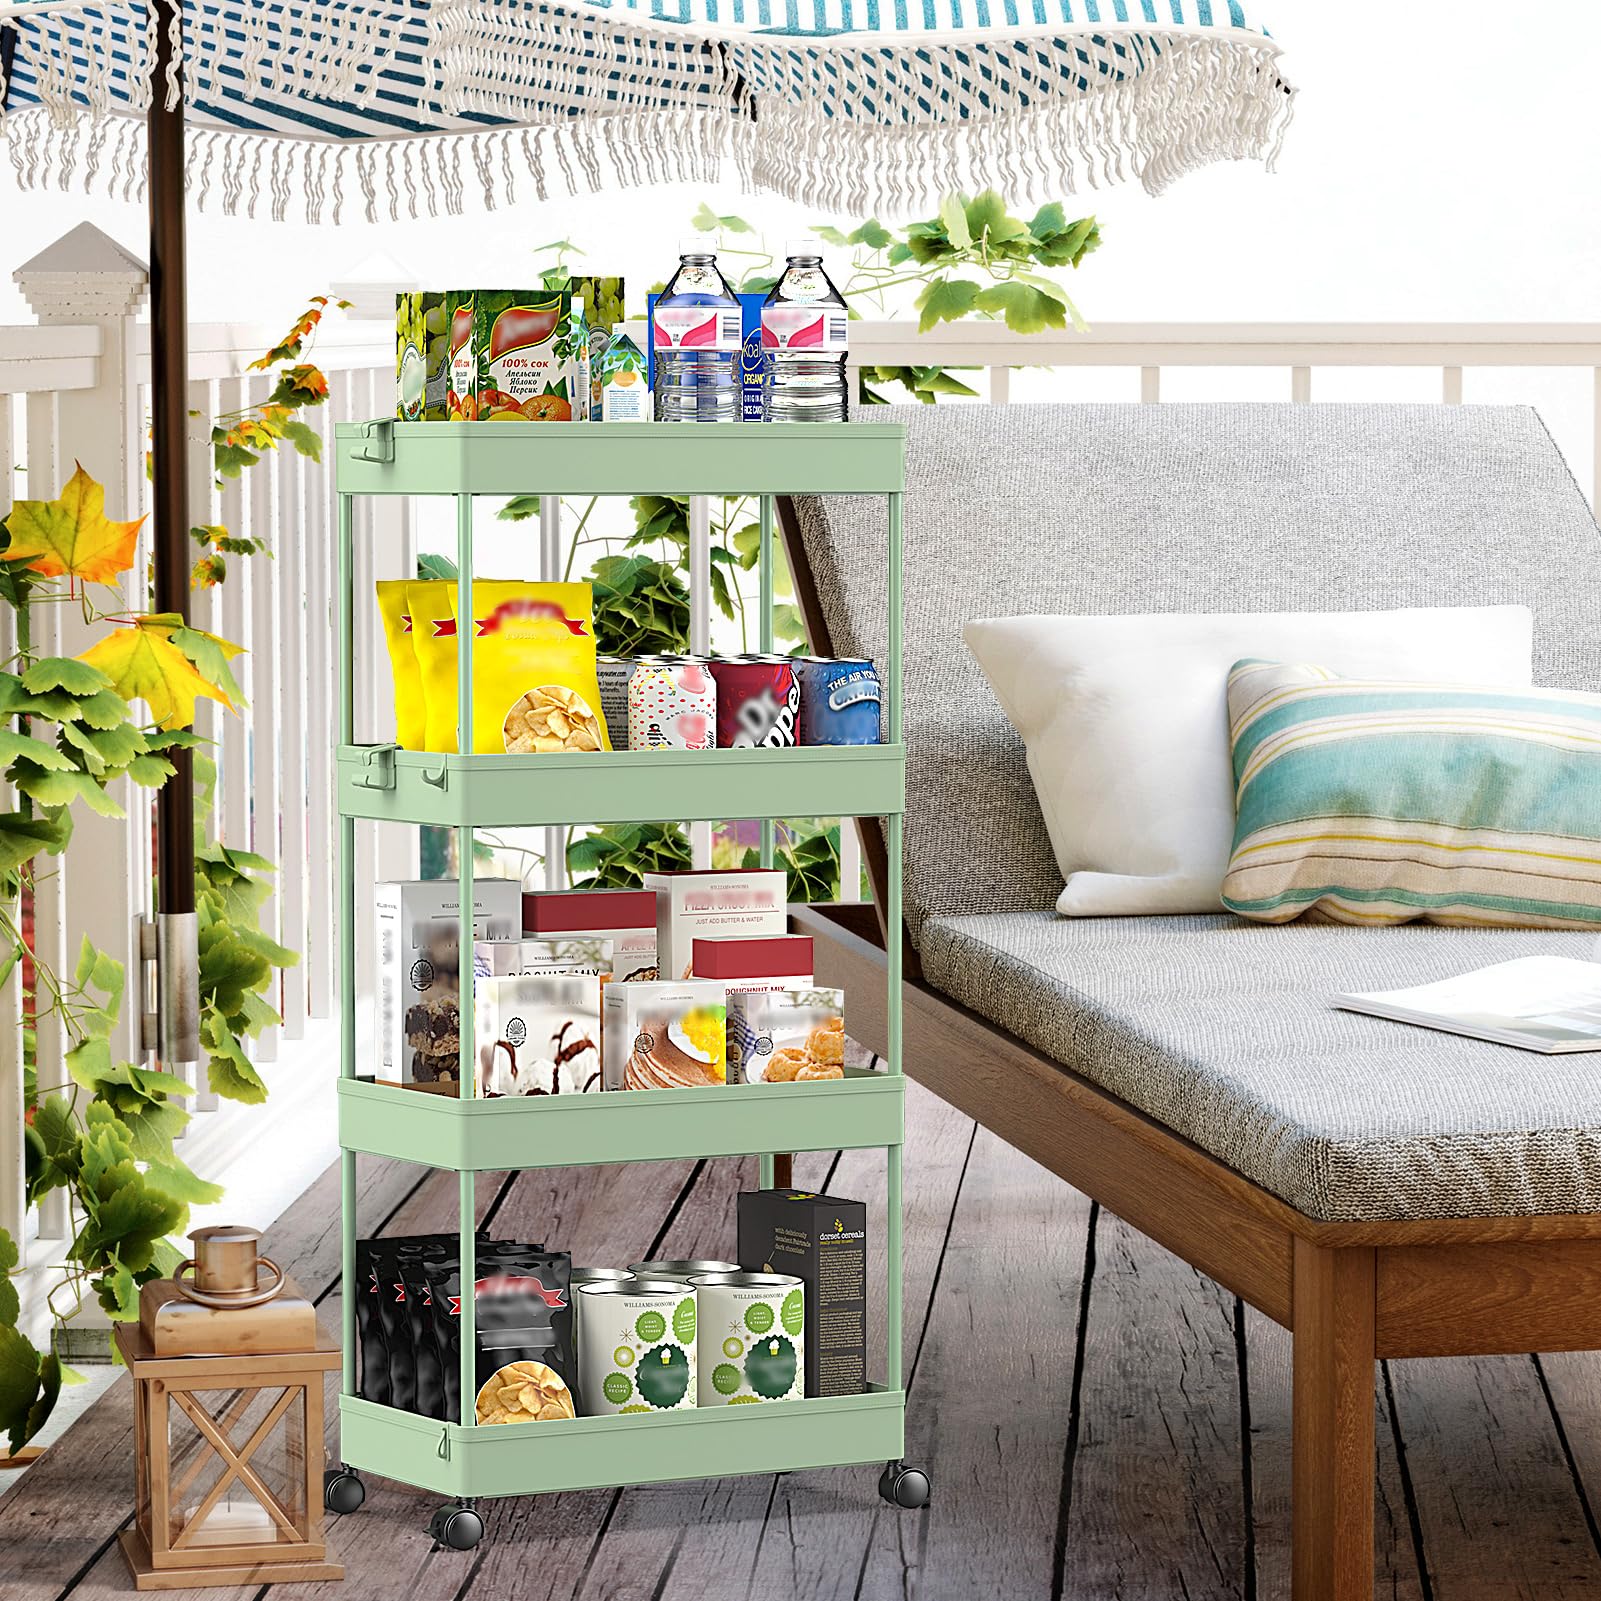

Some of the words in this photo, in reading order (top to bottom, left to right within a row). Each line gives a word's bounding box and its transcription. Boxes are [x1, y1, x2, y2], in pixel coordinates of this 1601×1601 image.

[502, 359, 528, 368] 100%
[528, 360, 549, 368] сок
[505, 369, 541, 378] Апельсин
[509, 378, 538, 386] Яблоко
[509, 386, 538, 394] Персик
[828, 676, 847, 691] THE
[848, 671, 862, 682] AIR
[861, 670, 876, 679] YOU
[819, 1232, 841, 1241] dorset
[841, 1231, 865, 1239] cereals
